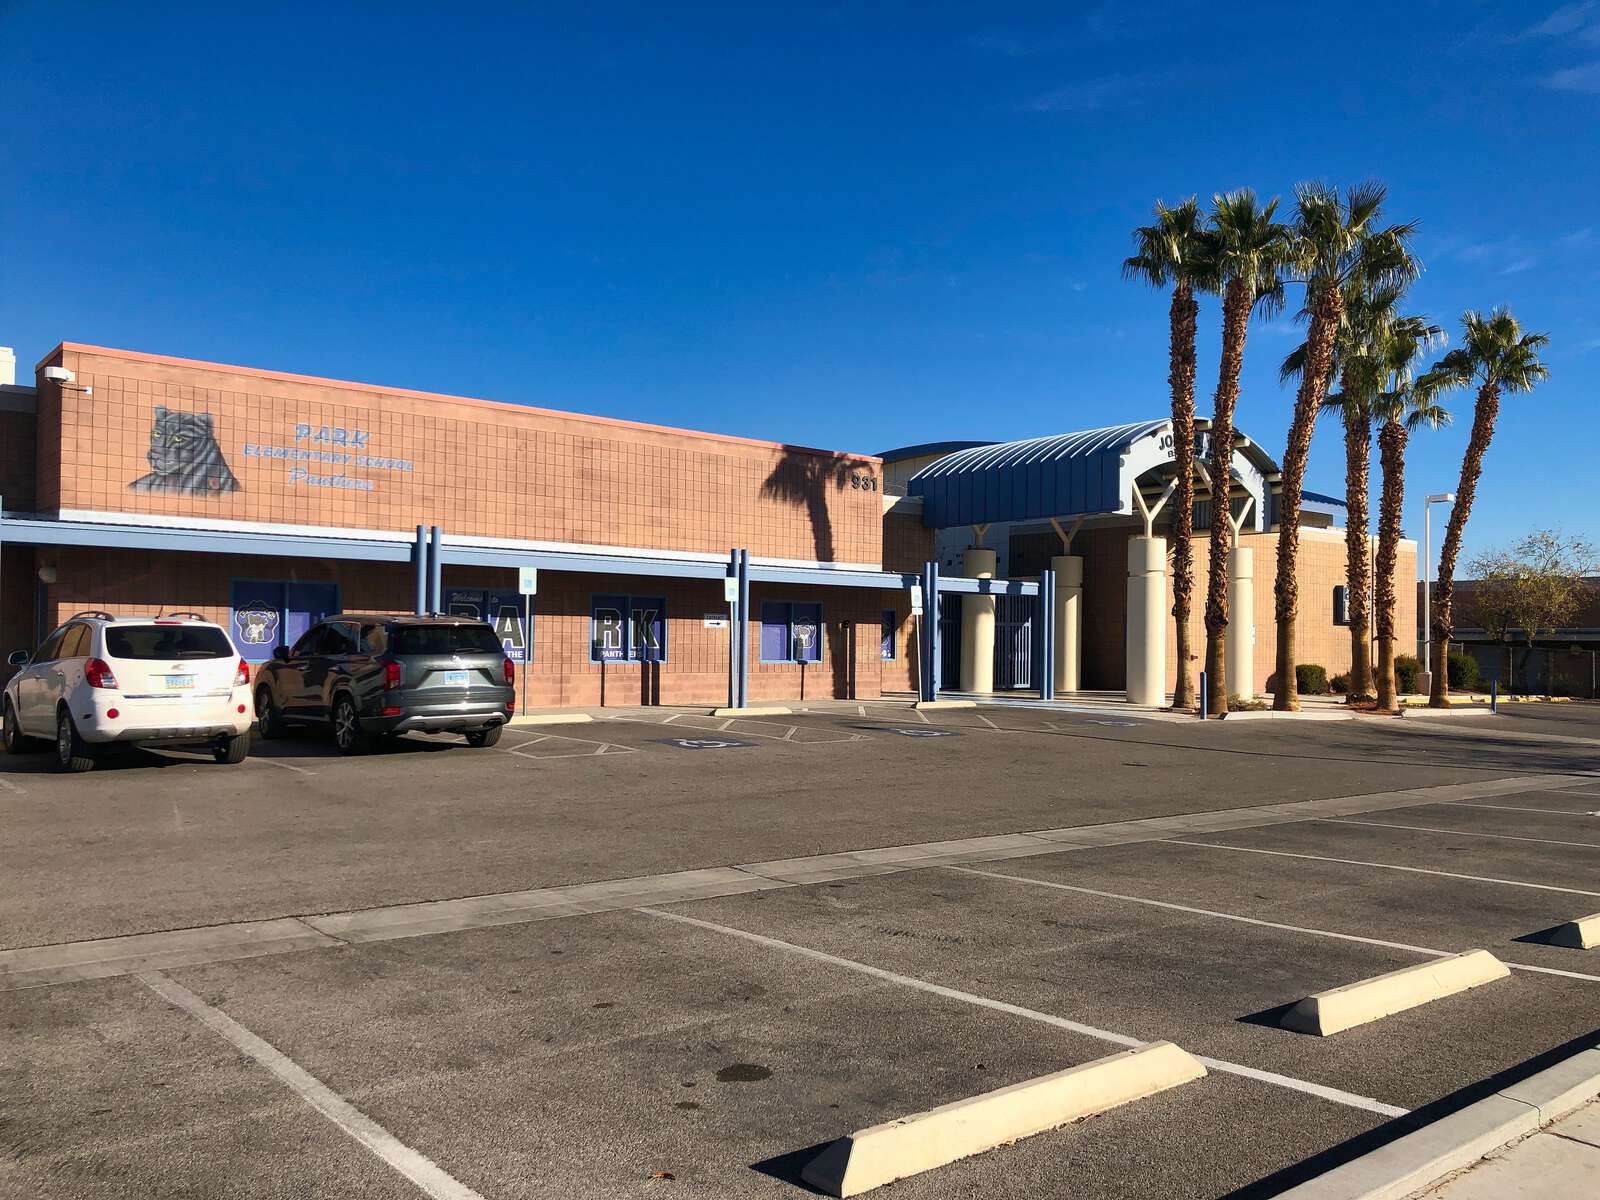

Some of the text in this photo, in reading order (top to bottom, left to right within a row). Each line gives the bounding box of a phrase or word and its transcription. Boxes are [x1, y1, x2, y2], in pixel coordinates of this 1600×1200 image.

[295, 423, 370, 448] PARK
[1159, 434, 1174, 450] JO
[244, 443, 414, 472] ELEMENTARY SCHOOL
[851, 474, 877, 491] 931
[507, 650, 523, 658] THE
